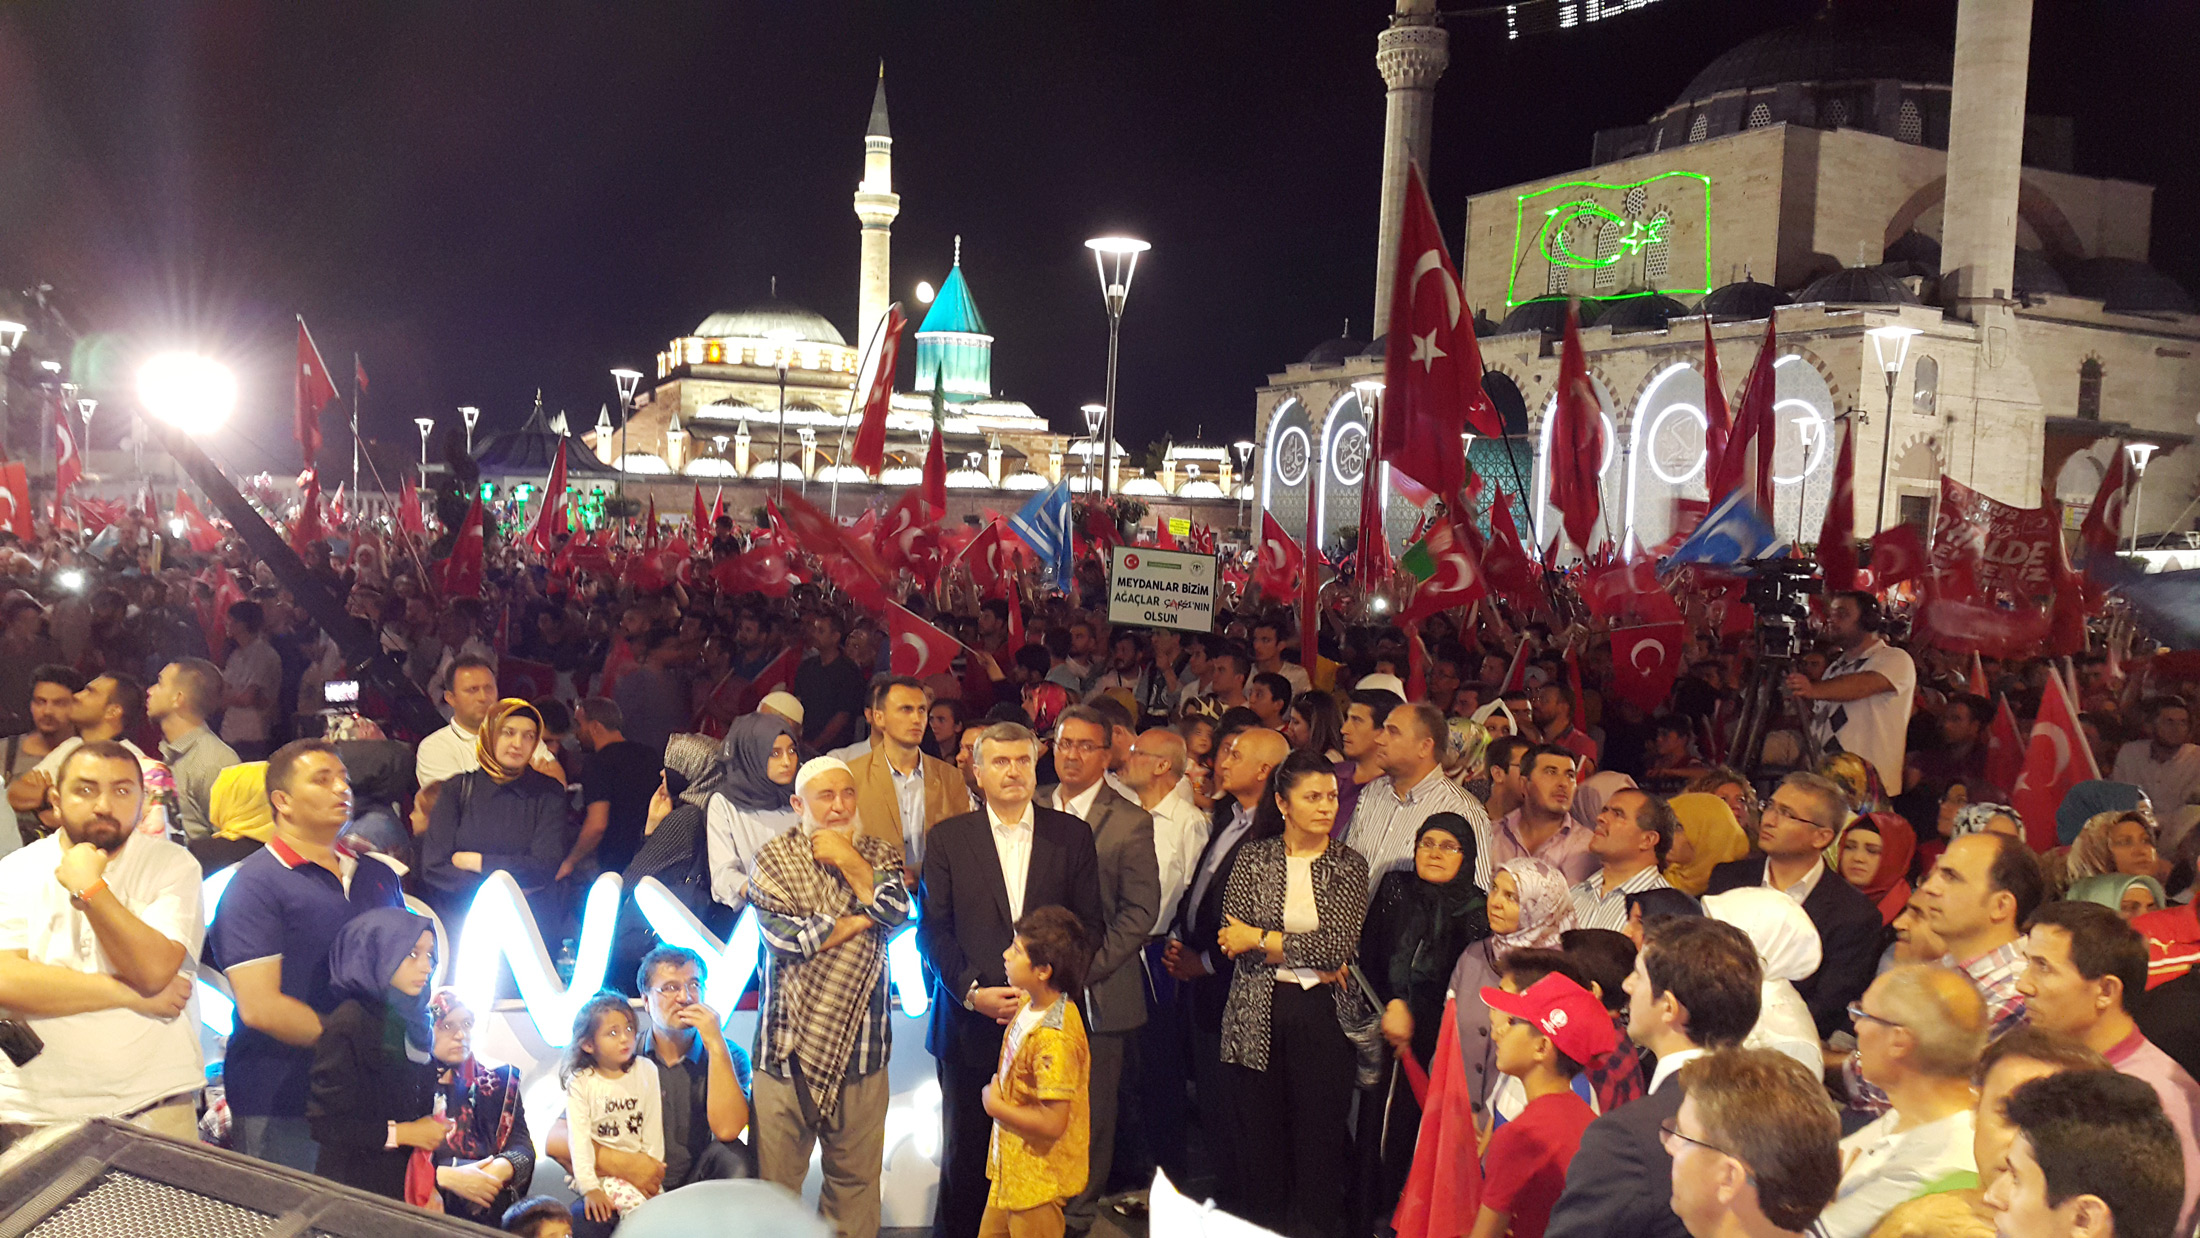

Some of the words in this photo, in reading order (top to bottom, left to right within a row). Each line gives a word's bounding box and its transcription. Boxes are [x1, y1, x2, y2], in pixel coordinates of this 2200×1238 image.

[1117, 577, 1179, 592] MEYDANLAR
[1182, 582, 1209, 596] BİZİM
[1114, 590, 1160, 606] AĞAÇLAR
[1144, 611, 1178, 624] OLSUN
